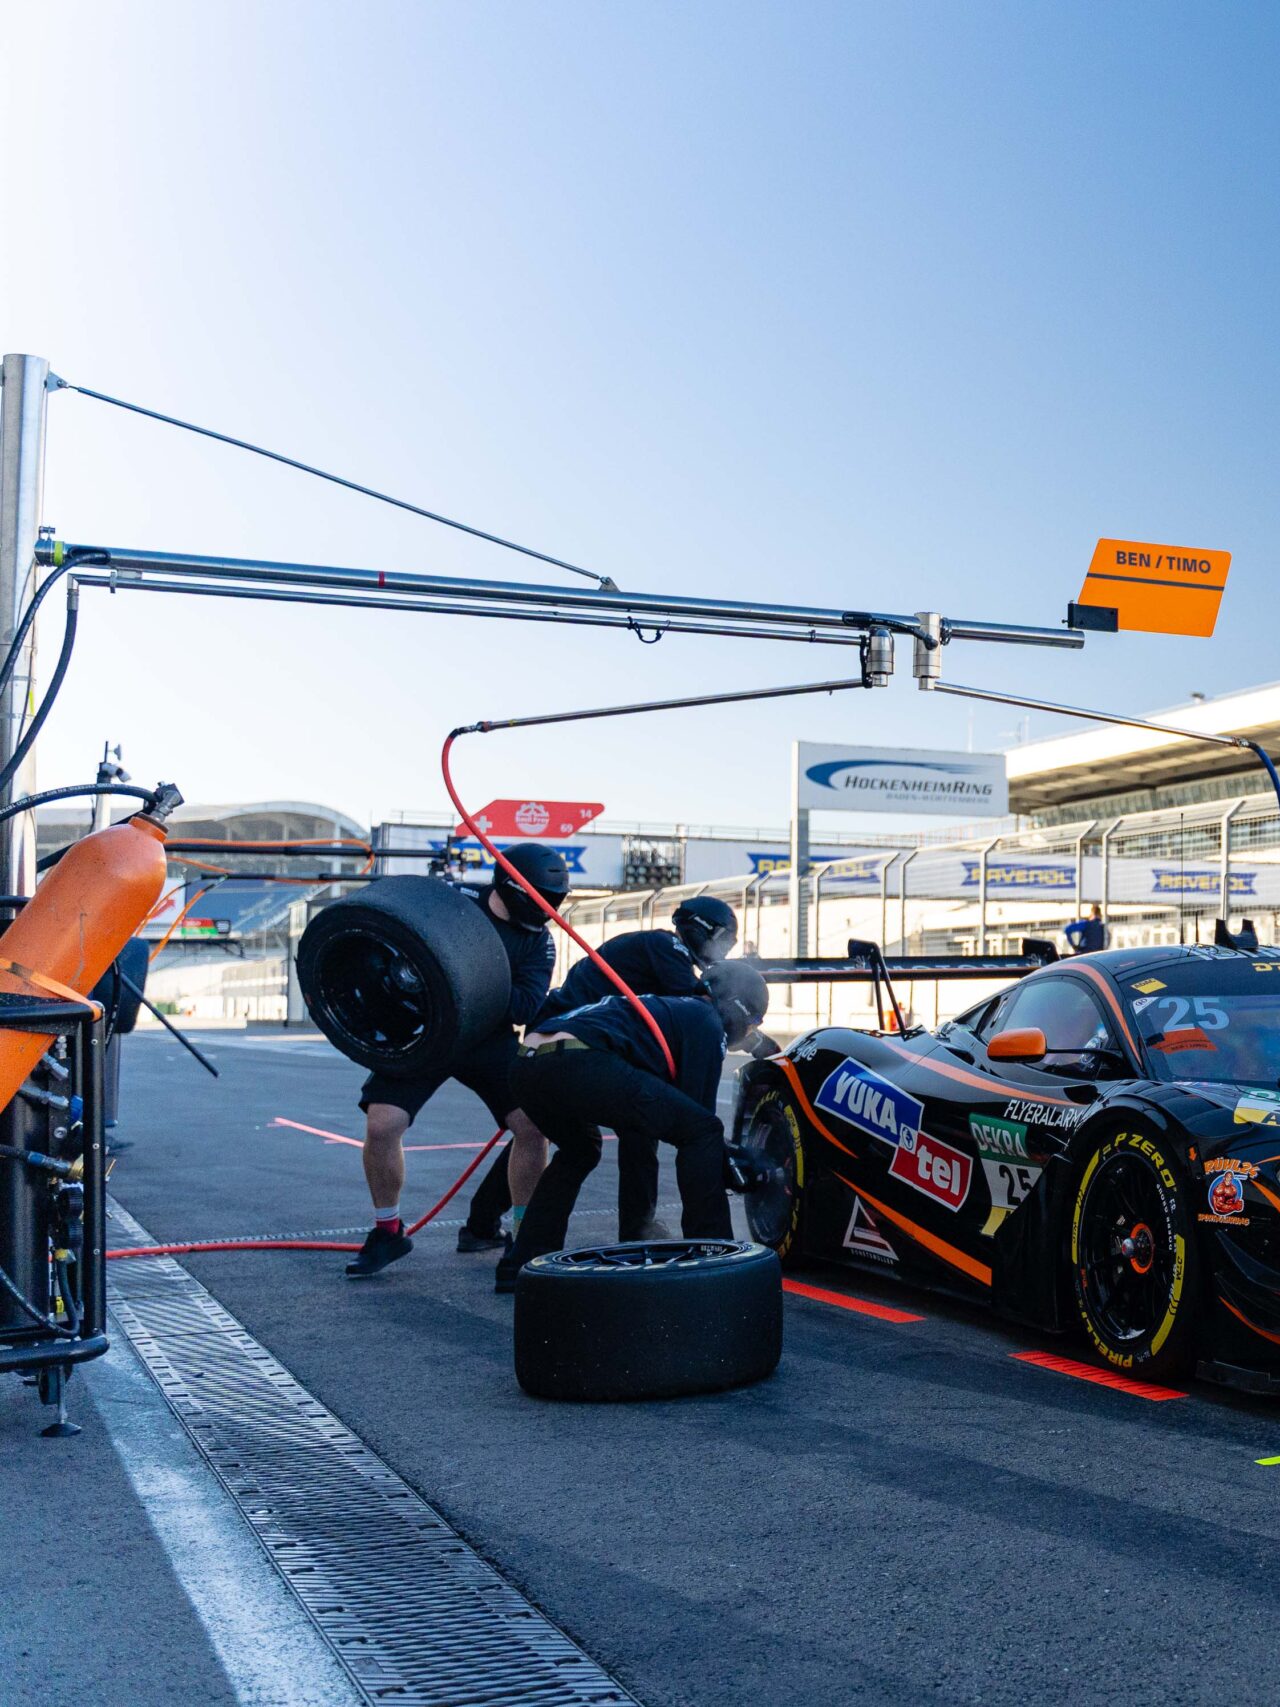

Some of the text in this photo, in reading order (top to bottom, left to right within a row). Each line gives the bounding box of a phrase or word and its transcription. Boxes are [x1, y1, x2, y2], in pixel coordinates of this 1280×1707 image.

[1116, 550, 1211, 574] BEN / TIMO
[1158, 996, 1230, 1033] 25
[833, 1070, 898, 1136] YUKA
[1003, 1099, 1084, 1130] FLYERALARM
[970, 1122, 1030, 1160] DEKRA
[916, 1144, 961, 1196] tel
[1128, 1133, 1177, 1188] ZERO
